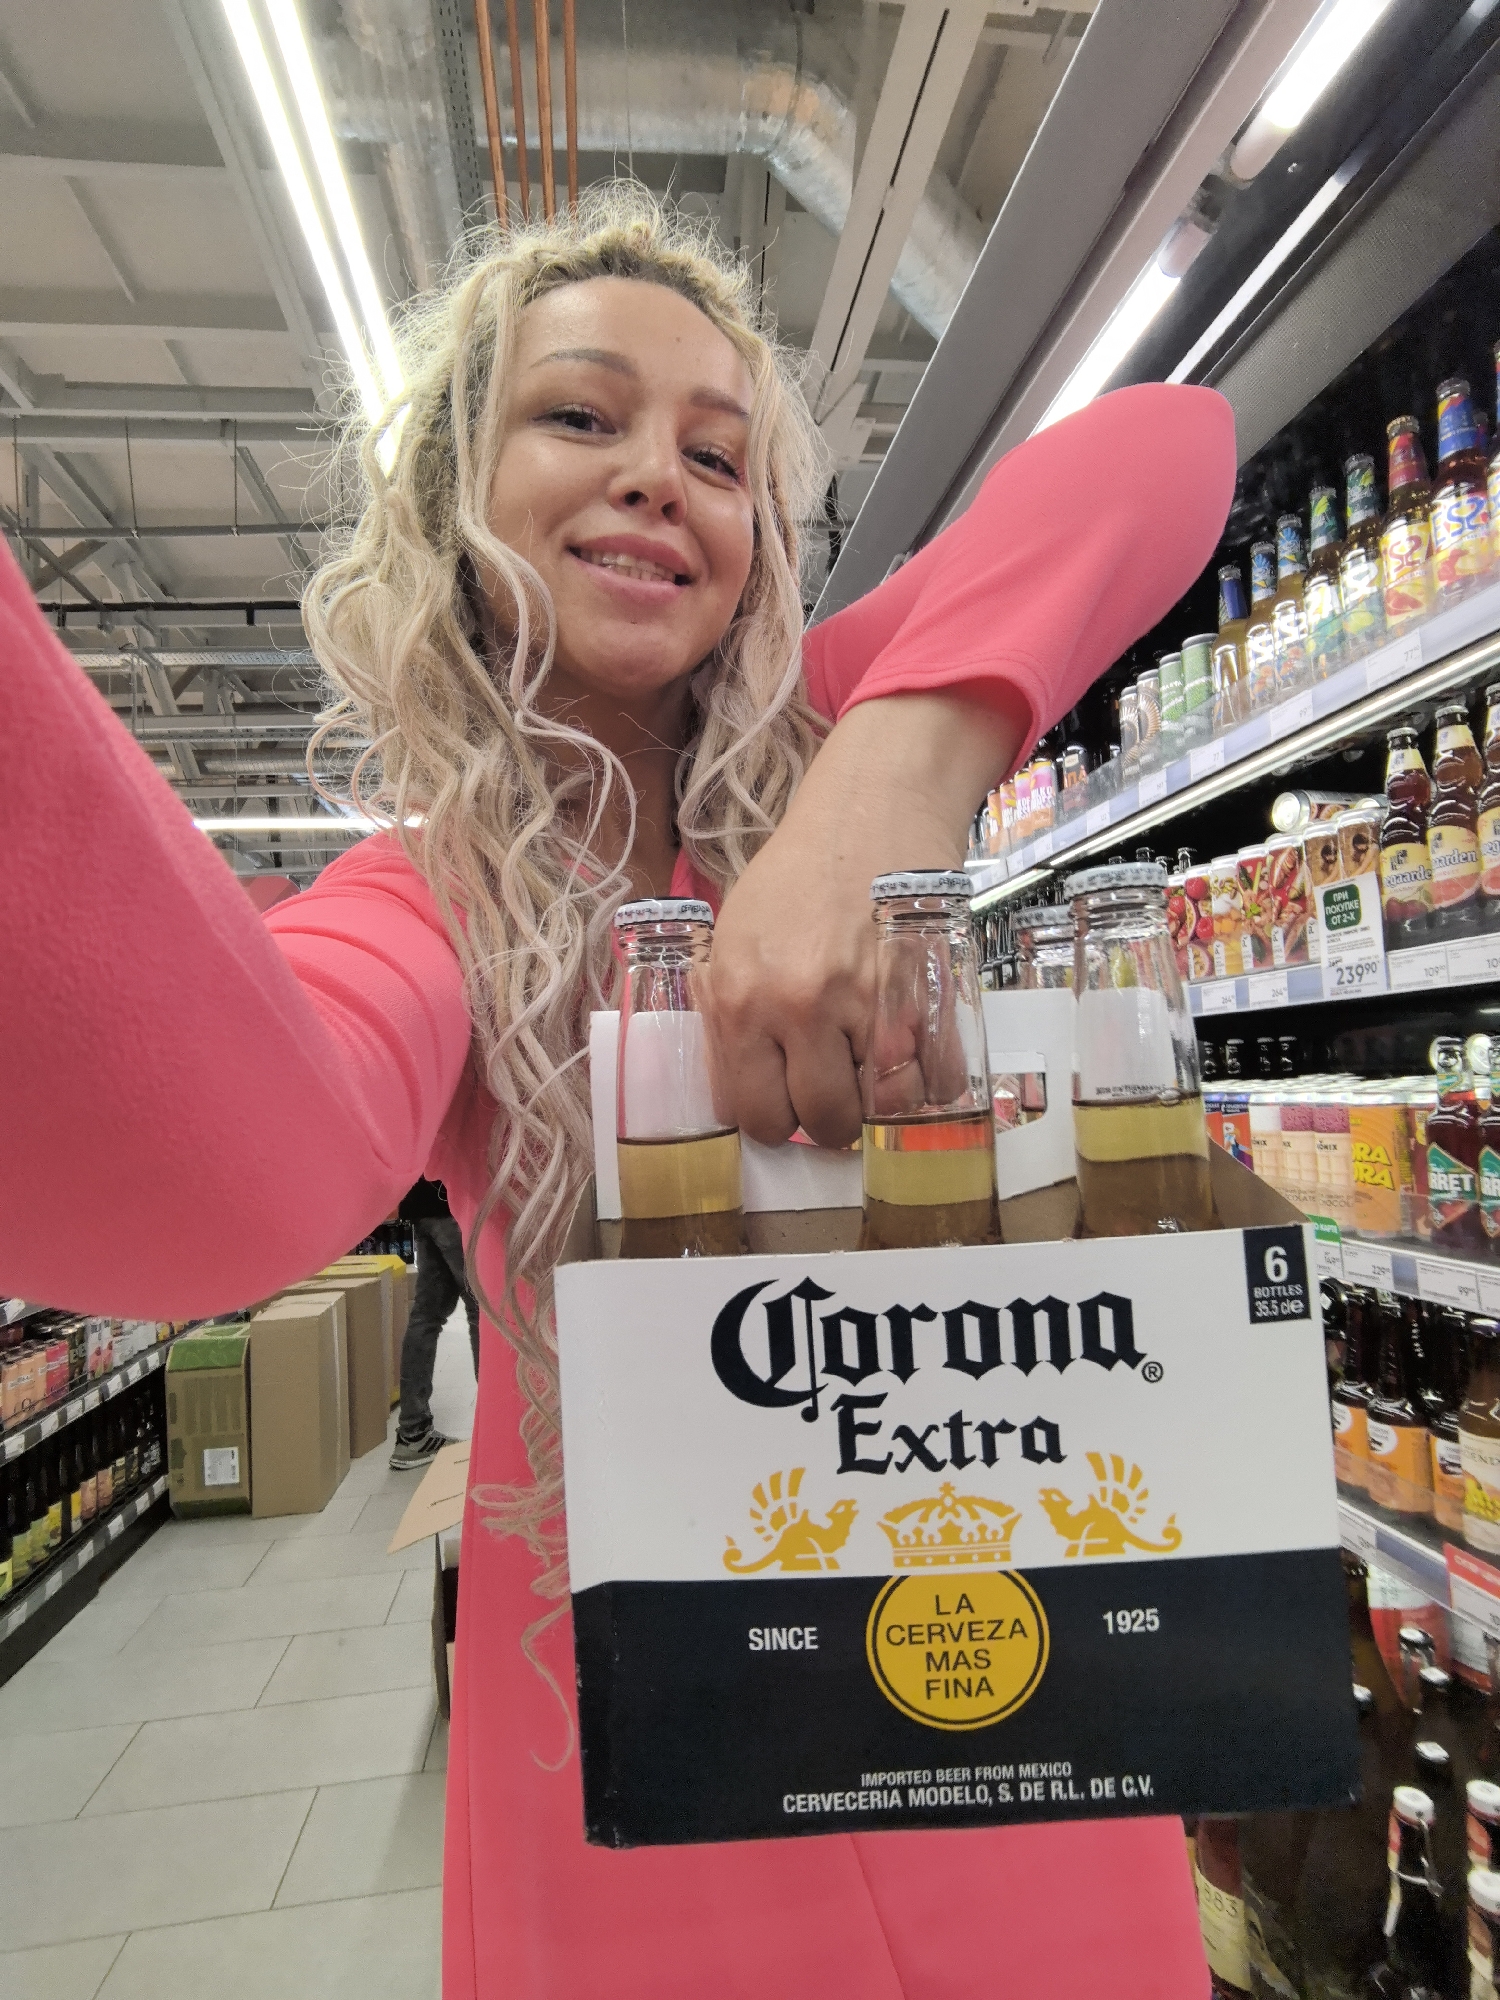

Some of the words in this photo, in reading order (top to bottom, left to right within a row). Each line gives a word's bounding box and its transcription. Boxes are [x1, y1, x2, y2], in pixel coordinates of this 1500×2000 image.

[1325, 899, 1359, 915] ПОКУПКЕ
[1333, 890, 1349, 903] ПРИ
[1264, 1246, 1288, 1282] 6
[1253, 1284, 1303, 1299] BOTTLES
[1255, 1300, 1279, 1317] 35.5
[710, 1276, 1147, 1423] Corona
[830, 1392, 1067, 1475] Extra
[935, 1593, 974, 1616] LA
[886, 1618, 1028, 1646] CERVEZA
[1102, 1608, 1161, 1635] 1925
[748, 1627, 819, 1651] SINCE
[925, 1648, 991, 1673] MAS
[925, 1676, 995, 1701] FINA
[861, 1769, 932, 1787] IMPORTED
[936, 1767, 971, 1783] BEER
[975, 1764, 1014, 1781] FROM
[1019, 1761, 1072, 1779] MEXICO
[783, 1789, 903, 1813] CERVECERIA
[908, 1784, 993, 1808] MODELO,
[998, 1783, 1014, 1803] S.
[1019, 1780, 1046, 1802] DE
[1090, 1776, 1116, 1799] DE
[1122, 1774, 1154, 1799] C.V.
